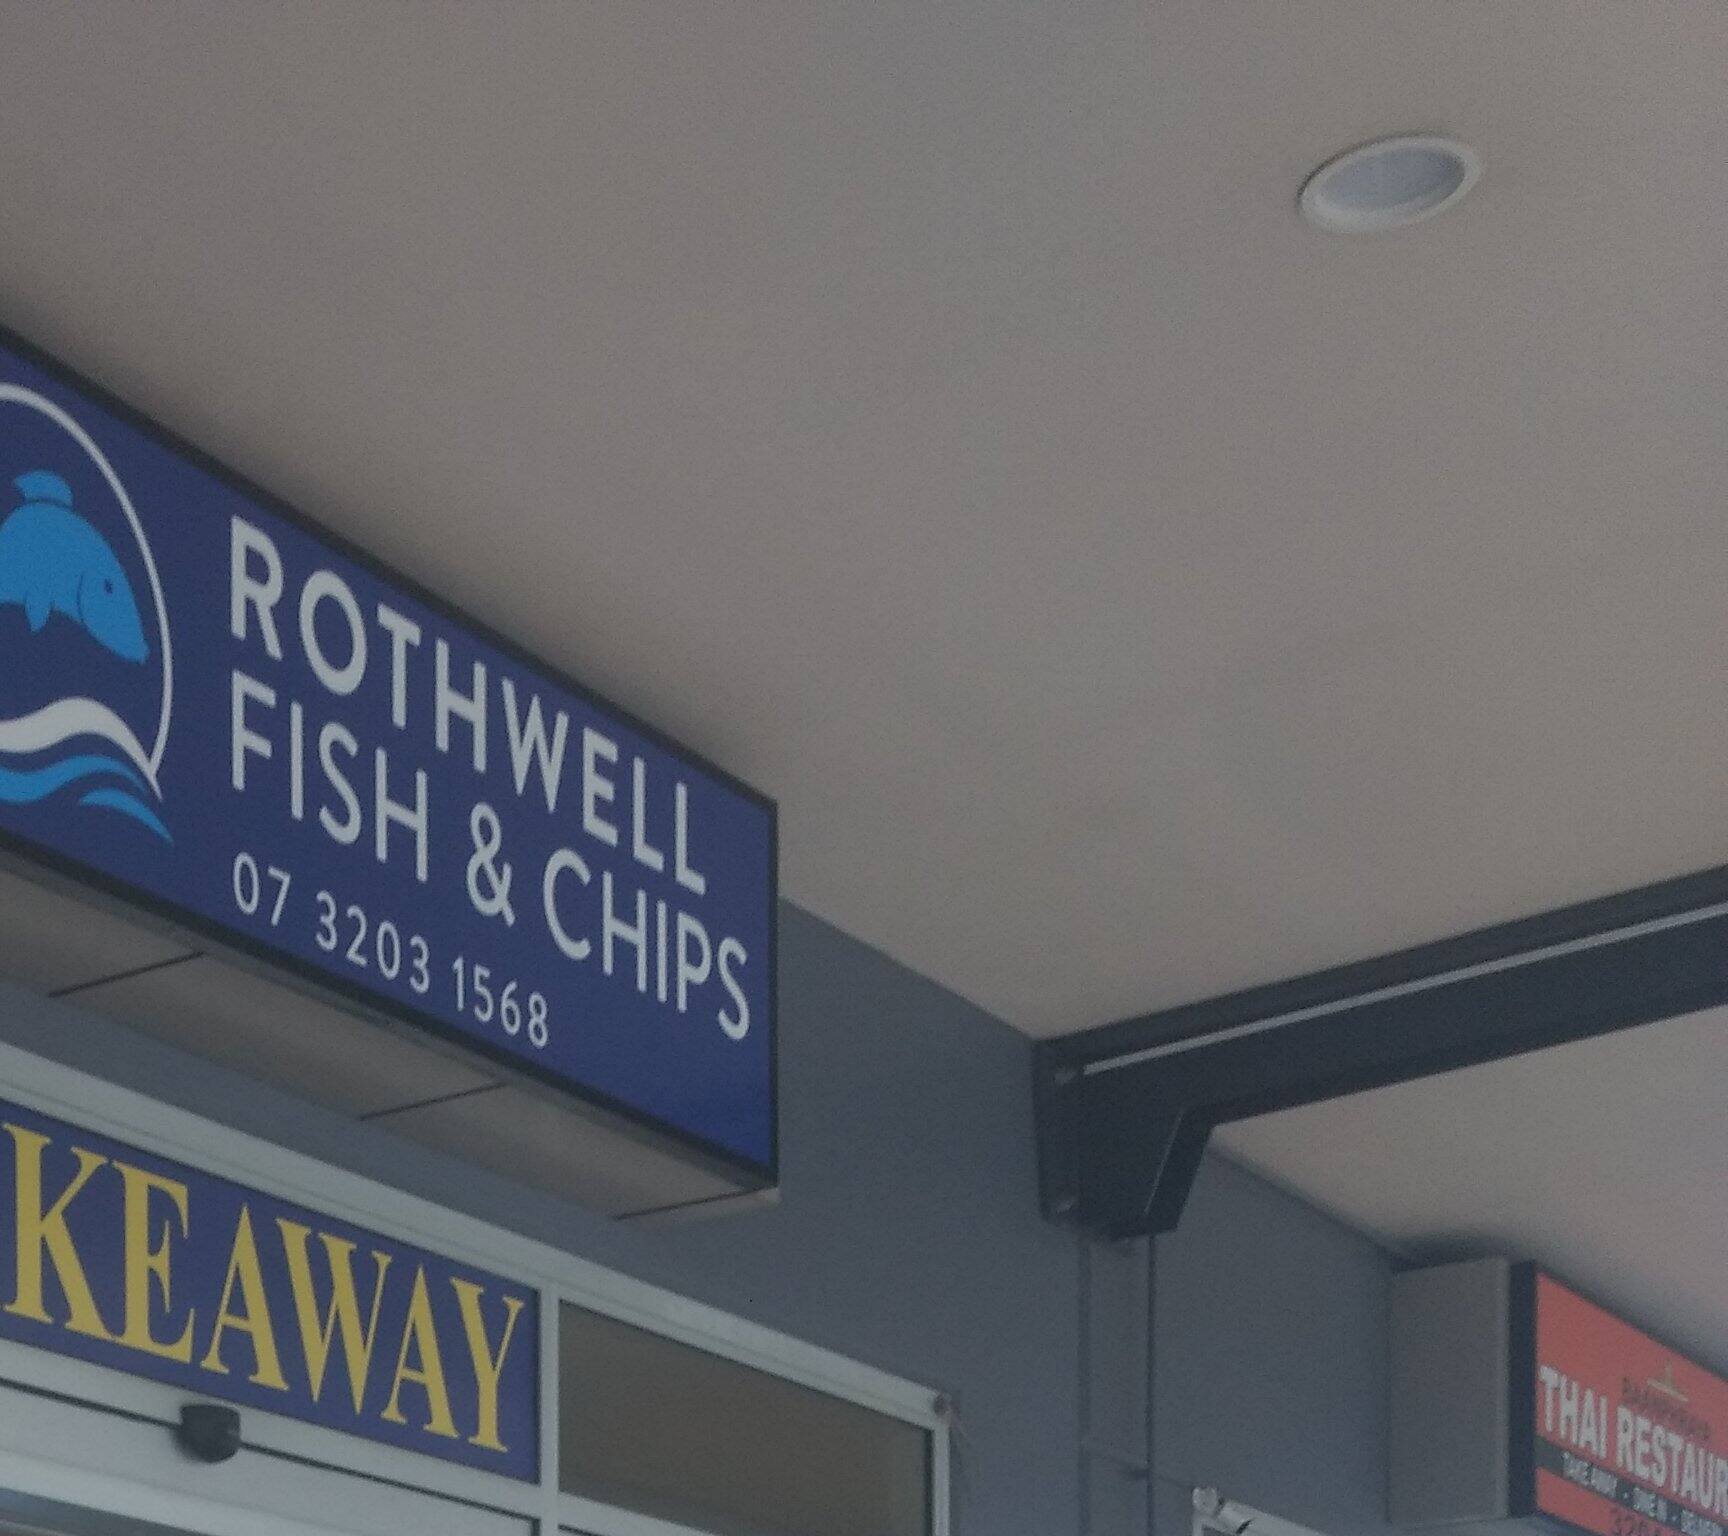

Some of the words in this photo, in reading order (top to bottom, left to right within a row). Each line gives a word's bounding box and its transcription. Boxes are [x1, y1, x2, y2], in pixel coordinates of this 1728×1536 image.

[230, 514, 706, 896] ROTHWELL
[230, 669, 431, 884] FISH
[466, 803, 517, 926] &
[543, 848, 750, 1041] CHIPS
[232, 852, 293, 928] 07
[316, 892, 432, 994] 3203
[452, 955, 549, 1048] 1568
[1539, 1365, 1609, 1459] THAI
